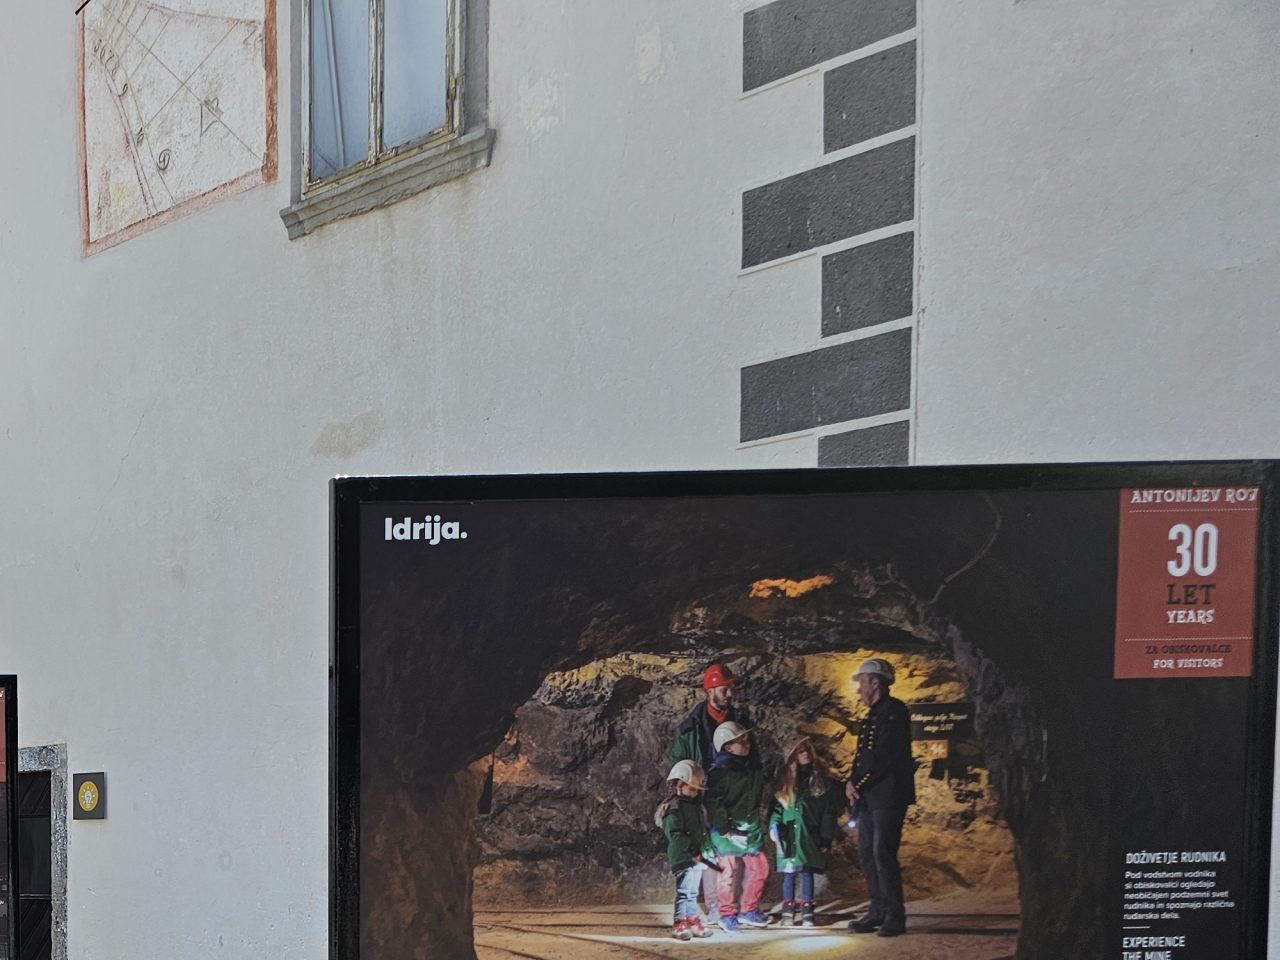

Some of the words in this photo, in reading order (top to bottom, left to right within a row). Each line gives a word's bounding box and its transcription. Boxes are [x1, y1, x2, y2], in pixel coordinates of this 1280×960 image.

[1131, 488, 1221, 503] ANTONIJEV
[384, 514, 468, 546] Idrija.
[1167, 522, 1218, 577] 30
[1167, 584, 1216, 605] LET
[1166, 610, 1215, 624] YEARS
[1144, 646, 1159, 655] ZA
[1152, 659, 1175, 669] FOR
[1176, 658, 1224, 668] VISITORS
[1126, 850, 1178, 864] DOŽIVETJE
[1180, 851, 1226, 862] RUDNIKA
[1122, 936, 1186, 948] EXPERIENCE
